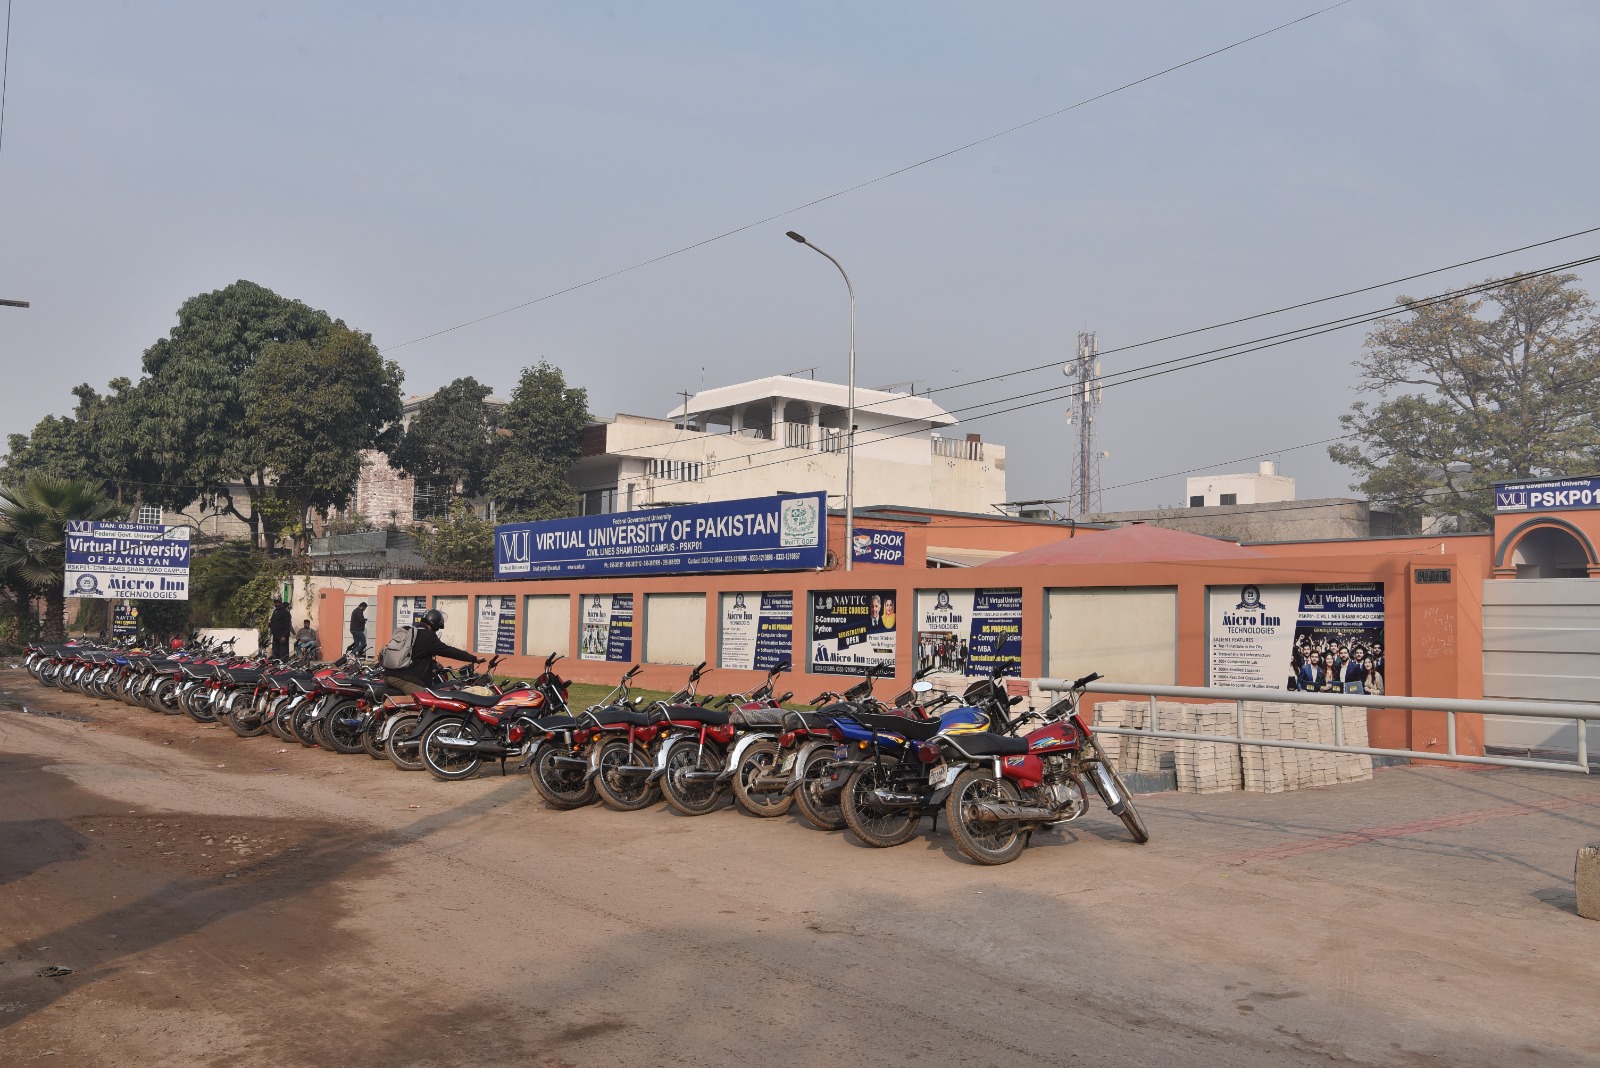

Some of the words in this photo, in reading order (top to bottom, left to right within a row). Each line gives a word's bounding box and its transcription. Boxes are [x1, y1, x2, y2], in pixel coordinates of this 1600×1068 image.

[1530, 488, 1600, 507] PSKP01
[651, 513, 671, 522] University
[536, 530, 585, 551] VIRTUAL
[588, 522, 668, 547] UNIVERSITY
[671, 520, 691, 541] OF
[696, 512, 778, 538] PAKISTAN
[873, 534, 903, 546] BOOK
[69, 538, 116, 554] Virtual
[120, 540, 187, 561] University
[600, 547, 615, 556] LINES
[616, 546, 632, 555] SHAMI
[633, 545, 649, 553] ROAD
[650, 542, 675, 552] CAMPUS
[679, 541, 702, 551] PSKP01
[873, 549, 902, 561] SHOP
[108, 557, 170, 566] PAKISTAN
[108, 576, 155, 589] Micro
[160, 577, 184, 590] Inn
[834, 596, 867, 605] NAVTTC
[926, 613, 947, 623] Micro
[950, 612, 962, 622] Inn
[1222, 613, 1257, 626] Micro
[1261, 613, 1280, 626] Inn
[815, 625, 832, 634] Python
[846, 636, 859, 645] OPEN
[830, 653, 851, 662] Micro
[854, 654, 865, 663] Inn
